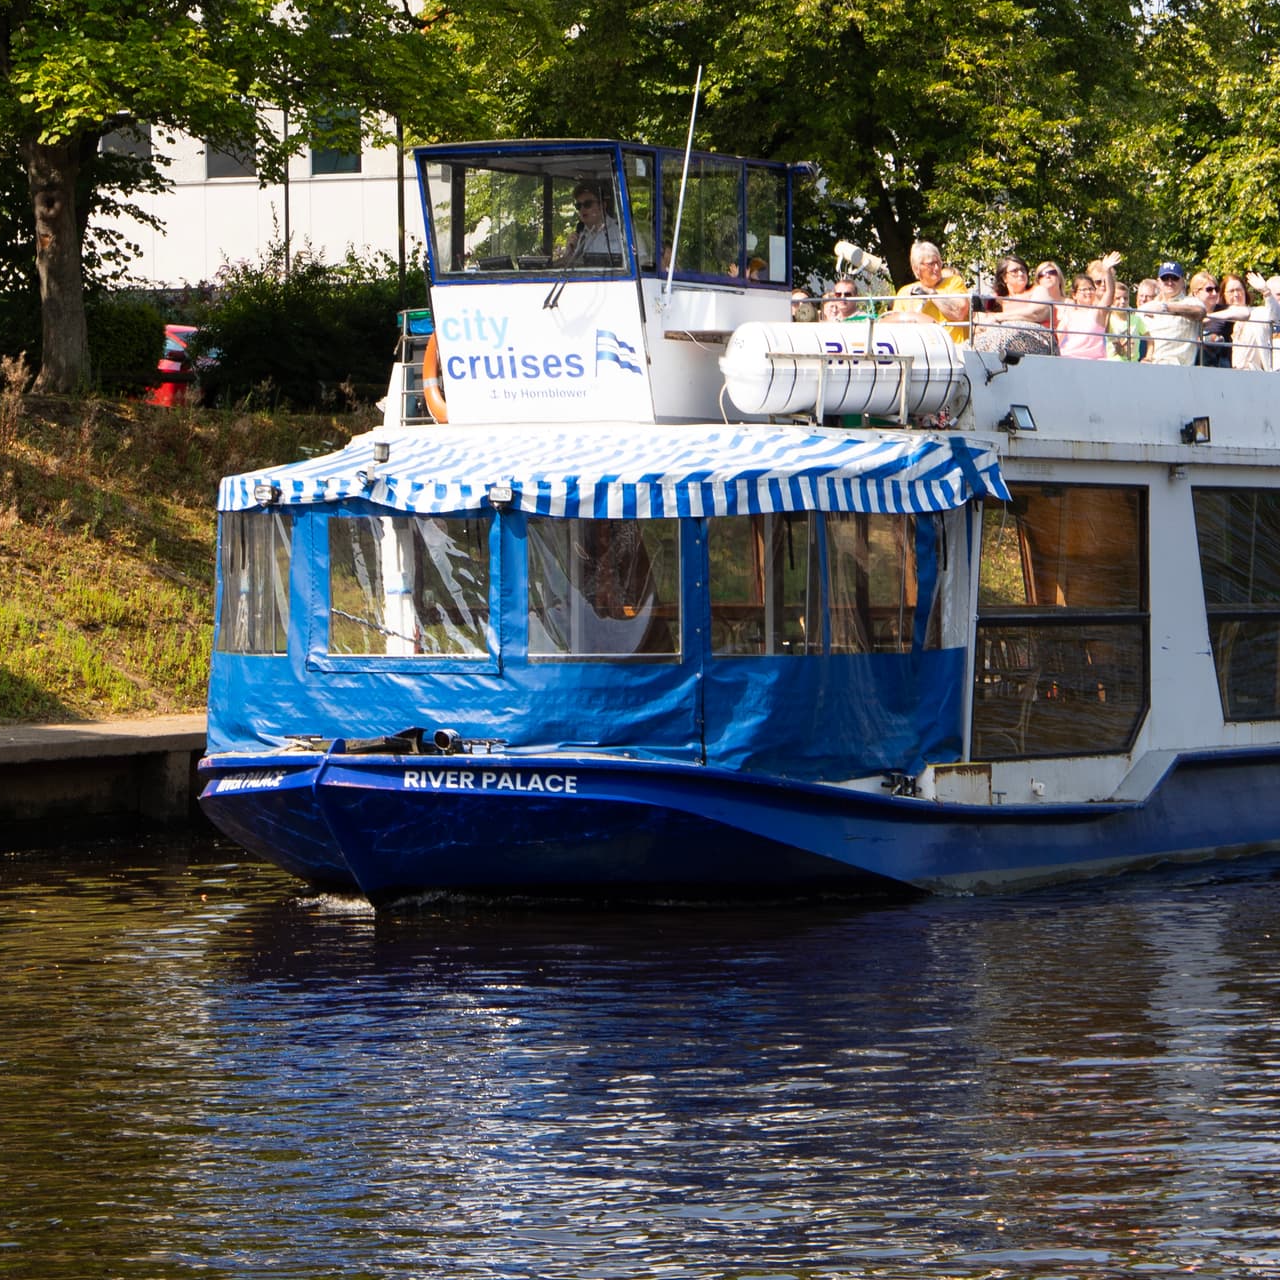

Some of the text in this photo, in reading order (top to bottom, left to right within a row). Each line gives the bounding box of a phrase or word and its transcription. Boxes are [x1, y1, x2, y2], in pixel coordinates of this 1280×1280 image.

[441, 307, 509, 349] city
[447, 346, 585, 380] cruises
[503, 387, 587, 401] by Hornblower
[403, 770, 578, 794] RIVER PALACE
